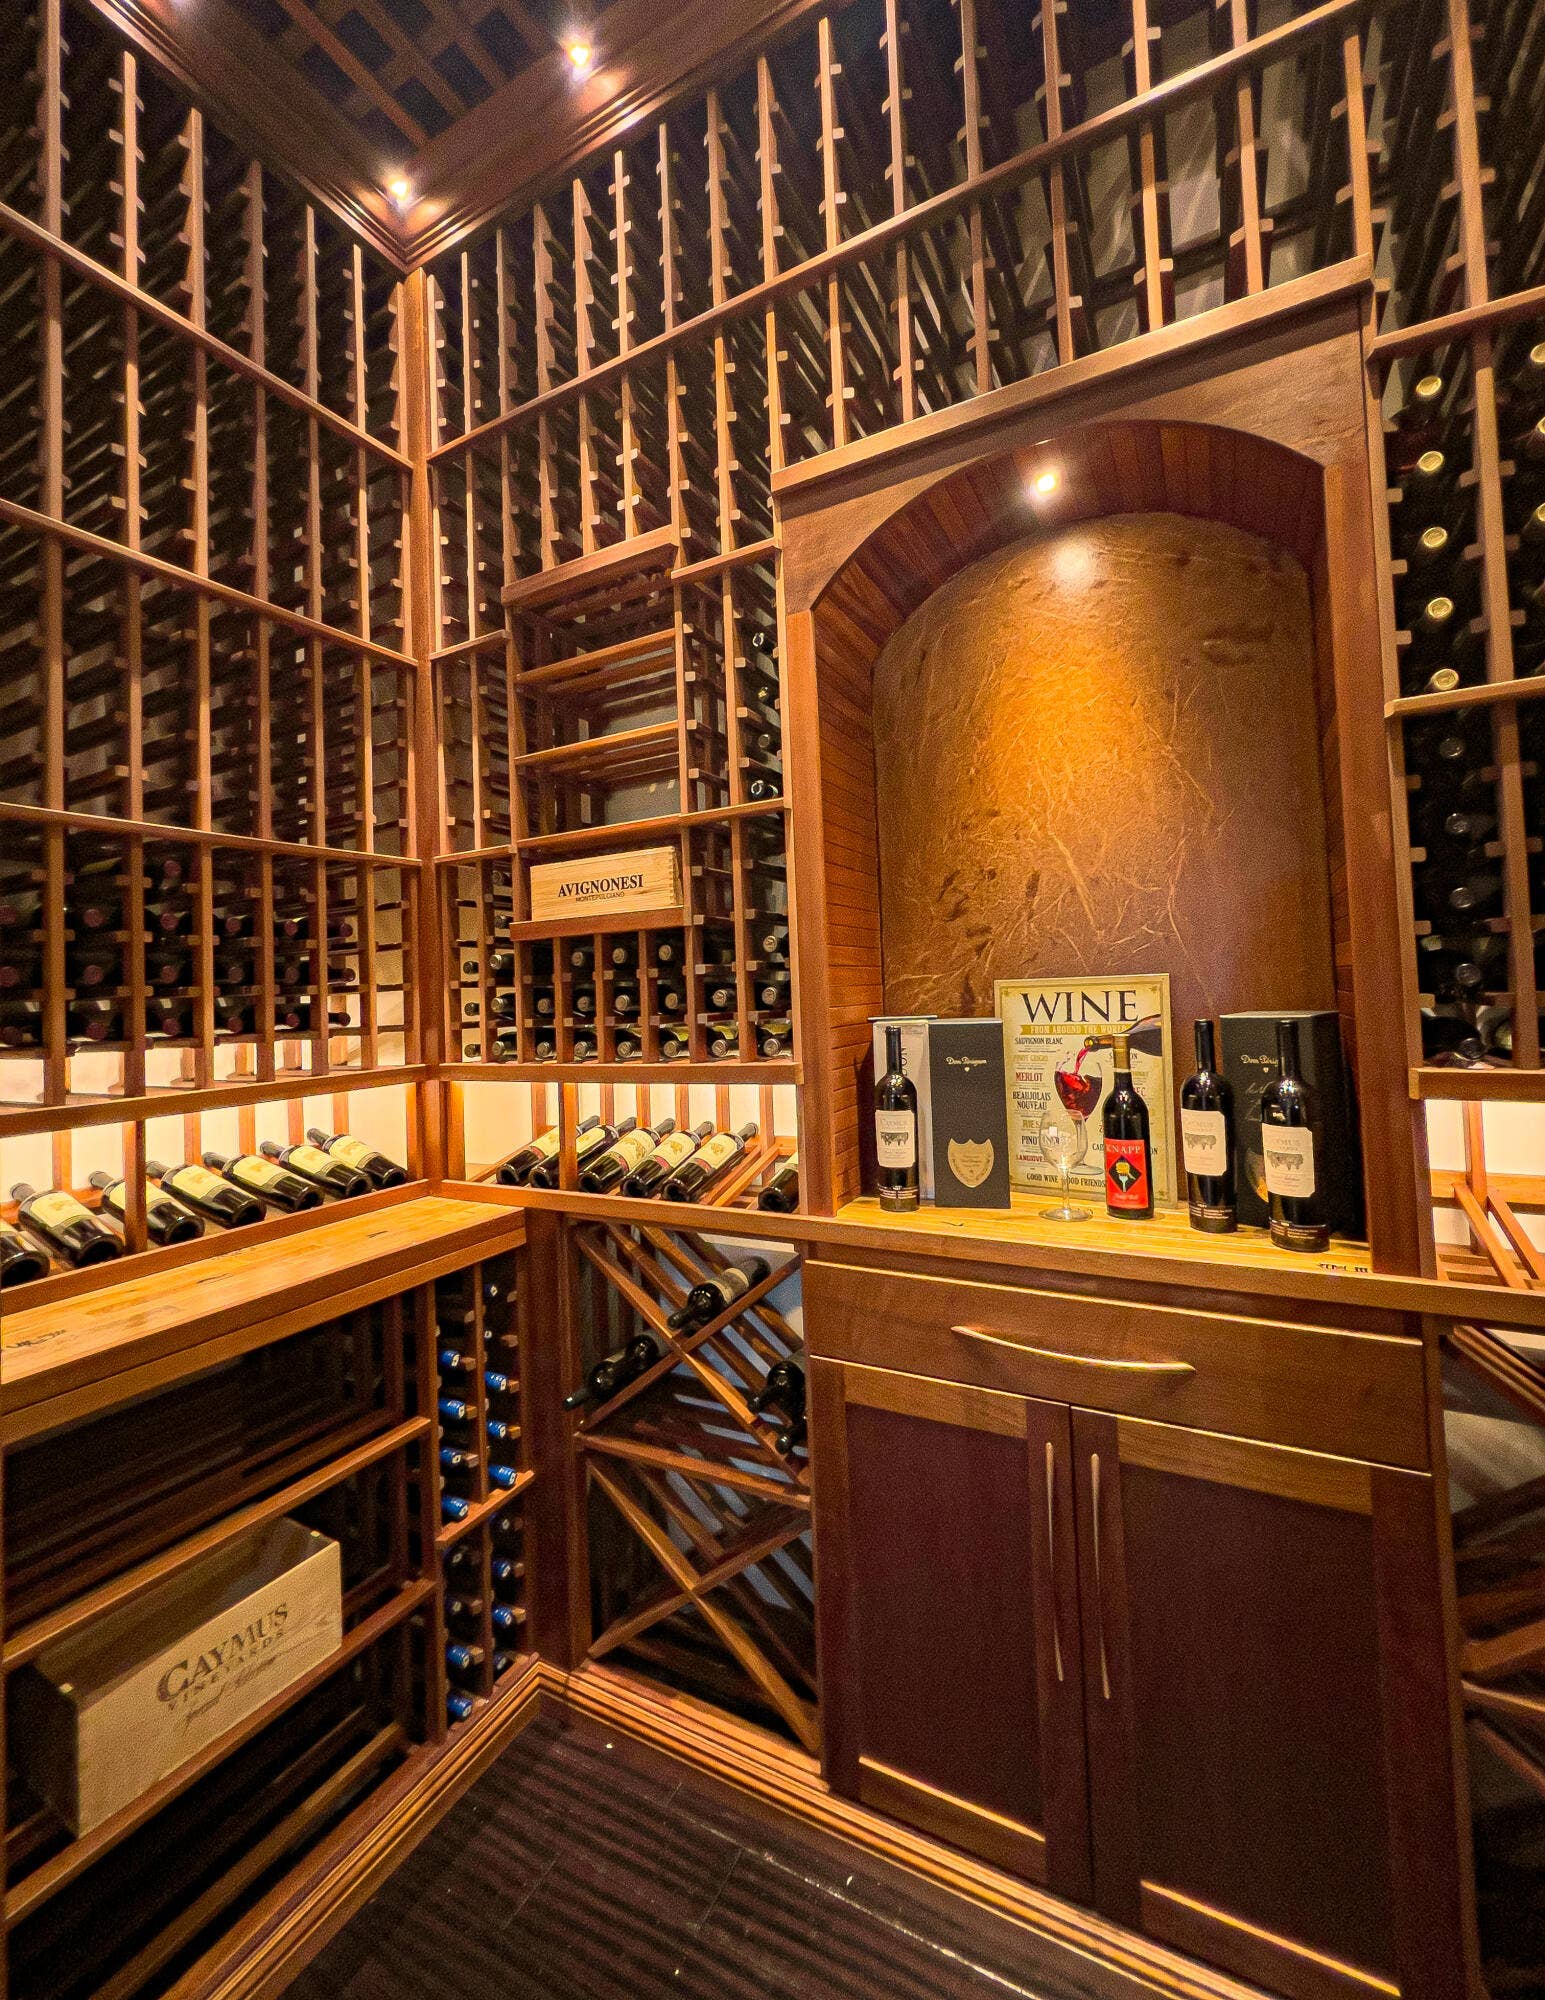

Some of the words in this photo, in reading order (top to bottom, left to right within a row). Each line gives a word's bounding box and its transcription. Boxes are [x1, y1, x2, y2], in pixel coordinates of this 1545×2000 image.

[558, 874, 643, 897] AVIGNONESI
[1020, 990, 1138, 1023] WINE
[1031, 1025, 1050, 1034] FROM
[1053, 1025, 1082, 1034] AROUND
[1084, 1025, 1097, 1033] THE
[1014, 1037, 1044, 1045] SAUVIGNON
[1016, 1072, 1043, 1082] MERLOT
[1013, 1091, 1051, 1101] BEAUJOLAIS
[1017, 1101, 1047, 1110] NOUVEAU
[1106, 1143, 1141, 1155] KNAPP
[1026, 1173, 1042, 1181] GOOD
[1043, 1174, 1058, 1183] WINE
[157, 1602, 288, 1702] CAYMUS
